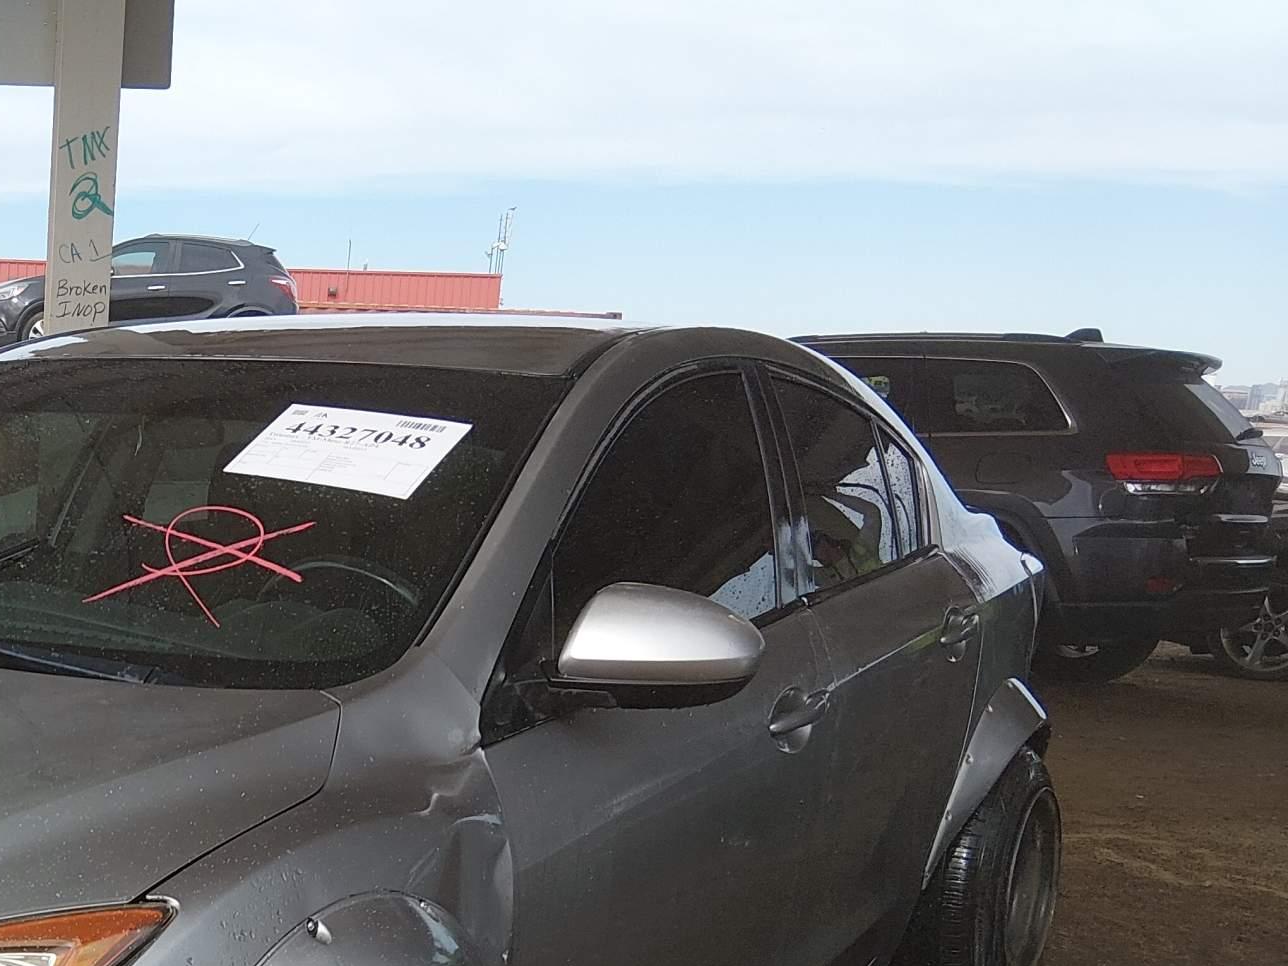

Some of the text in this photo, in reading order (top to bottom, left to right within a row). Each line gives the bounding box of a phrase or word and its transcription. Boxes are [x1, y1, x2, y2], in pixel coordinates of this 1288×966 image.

[58, 243, 82, 263] CA
[56, 279, 108, 298] Broken
[55, 301, 106, 322] INOP
[285, 421, 432, 450] 44327048
